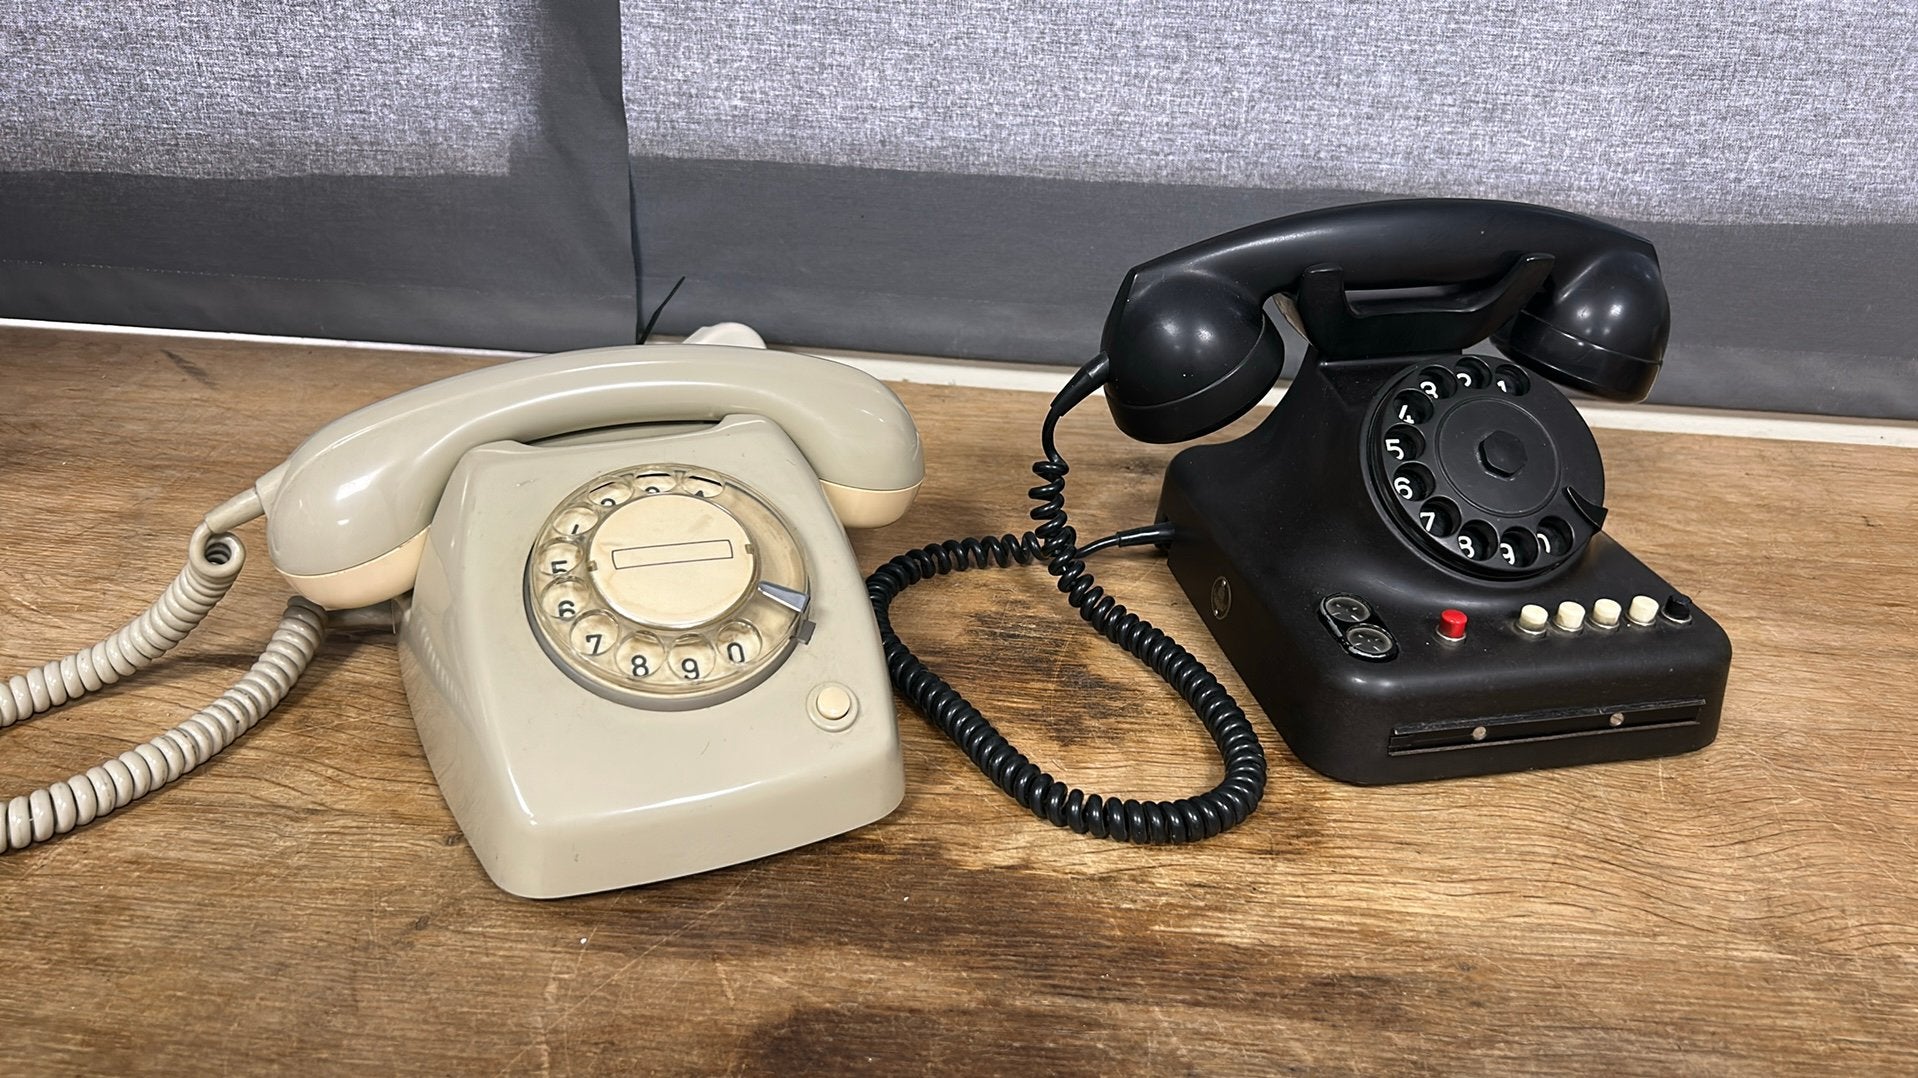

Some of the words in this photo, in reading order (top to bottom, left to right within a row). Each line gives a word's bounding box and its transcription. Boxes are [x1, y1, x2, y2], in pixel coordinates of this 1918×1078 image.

[1398, 404, 1415, 424] 4
[1385, 438, 1405, 461] 5
[1393, 476, 1413, 500] 6
[1419, 511, 1436, 532] 7
[1458, 535, 1475, 559] 8
[1499, 542, 1516, 565] 9
[551, 560, 568, 575] 5
[557, 600, 576, 618] 6
[585, 634, 603, 656] 7
[727, 642, 745, 663] 0
[631, 654, 649, 678] 8
[681, 658, 700, 680] 9
